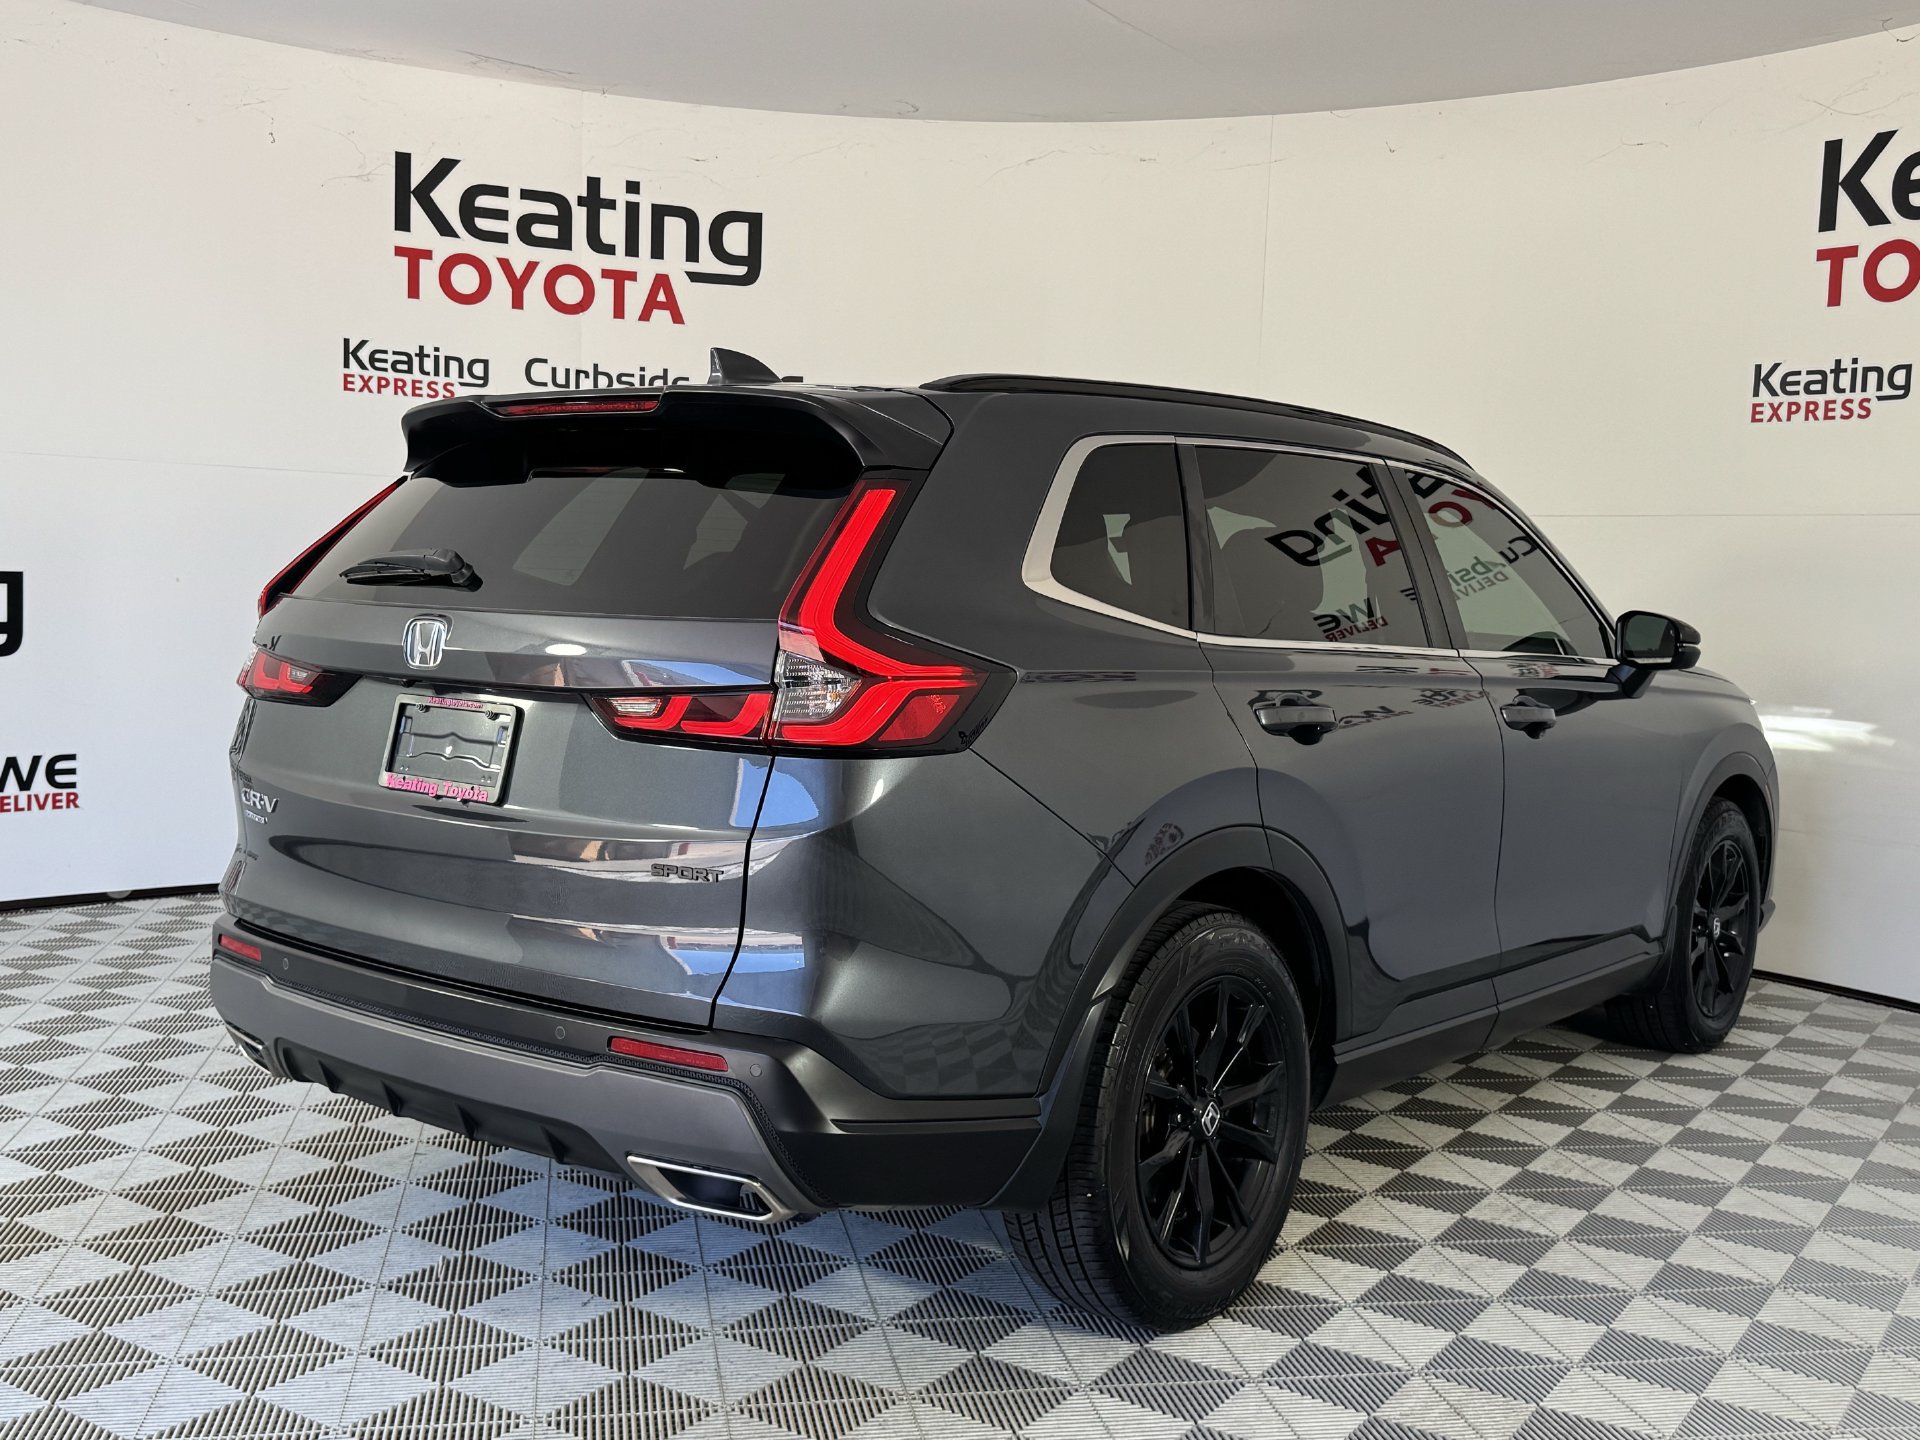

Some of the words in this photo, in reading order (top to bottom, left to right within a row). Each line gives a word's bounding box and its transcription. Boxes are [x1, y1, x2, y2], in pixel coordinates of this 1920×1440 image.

[395, 151, 762, 286] Keating
[394, 246, 685, 324] TOYOTA
[343, 337, 489, 387] Keating
[343, 374, 455, 398] EXPRESS
[1752, 358, 1912, 401] Keating
[1751, 398, 1872, 423] EXPRESS
[241, 787, 279, 813] CR-V
[386, 772, 438, 796] Keating
[443, 780, 488, 801] Toyota
[0, 792, 80, 813] ELIVER
[651, 863, 724, 882] SPORT
